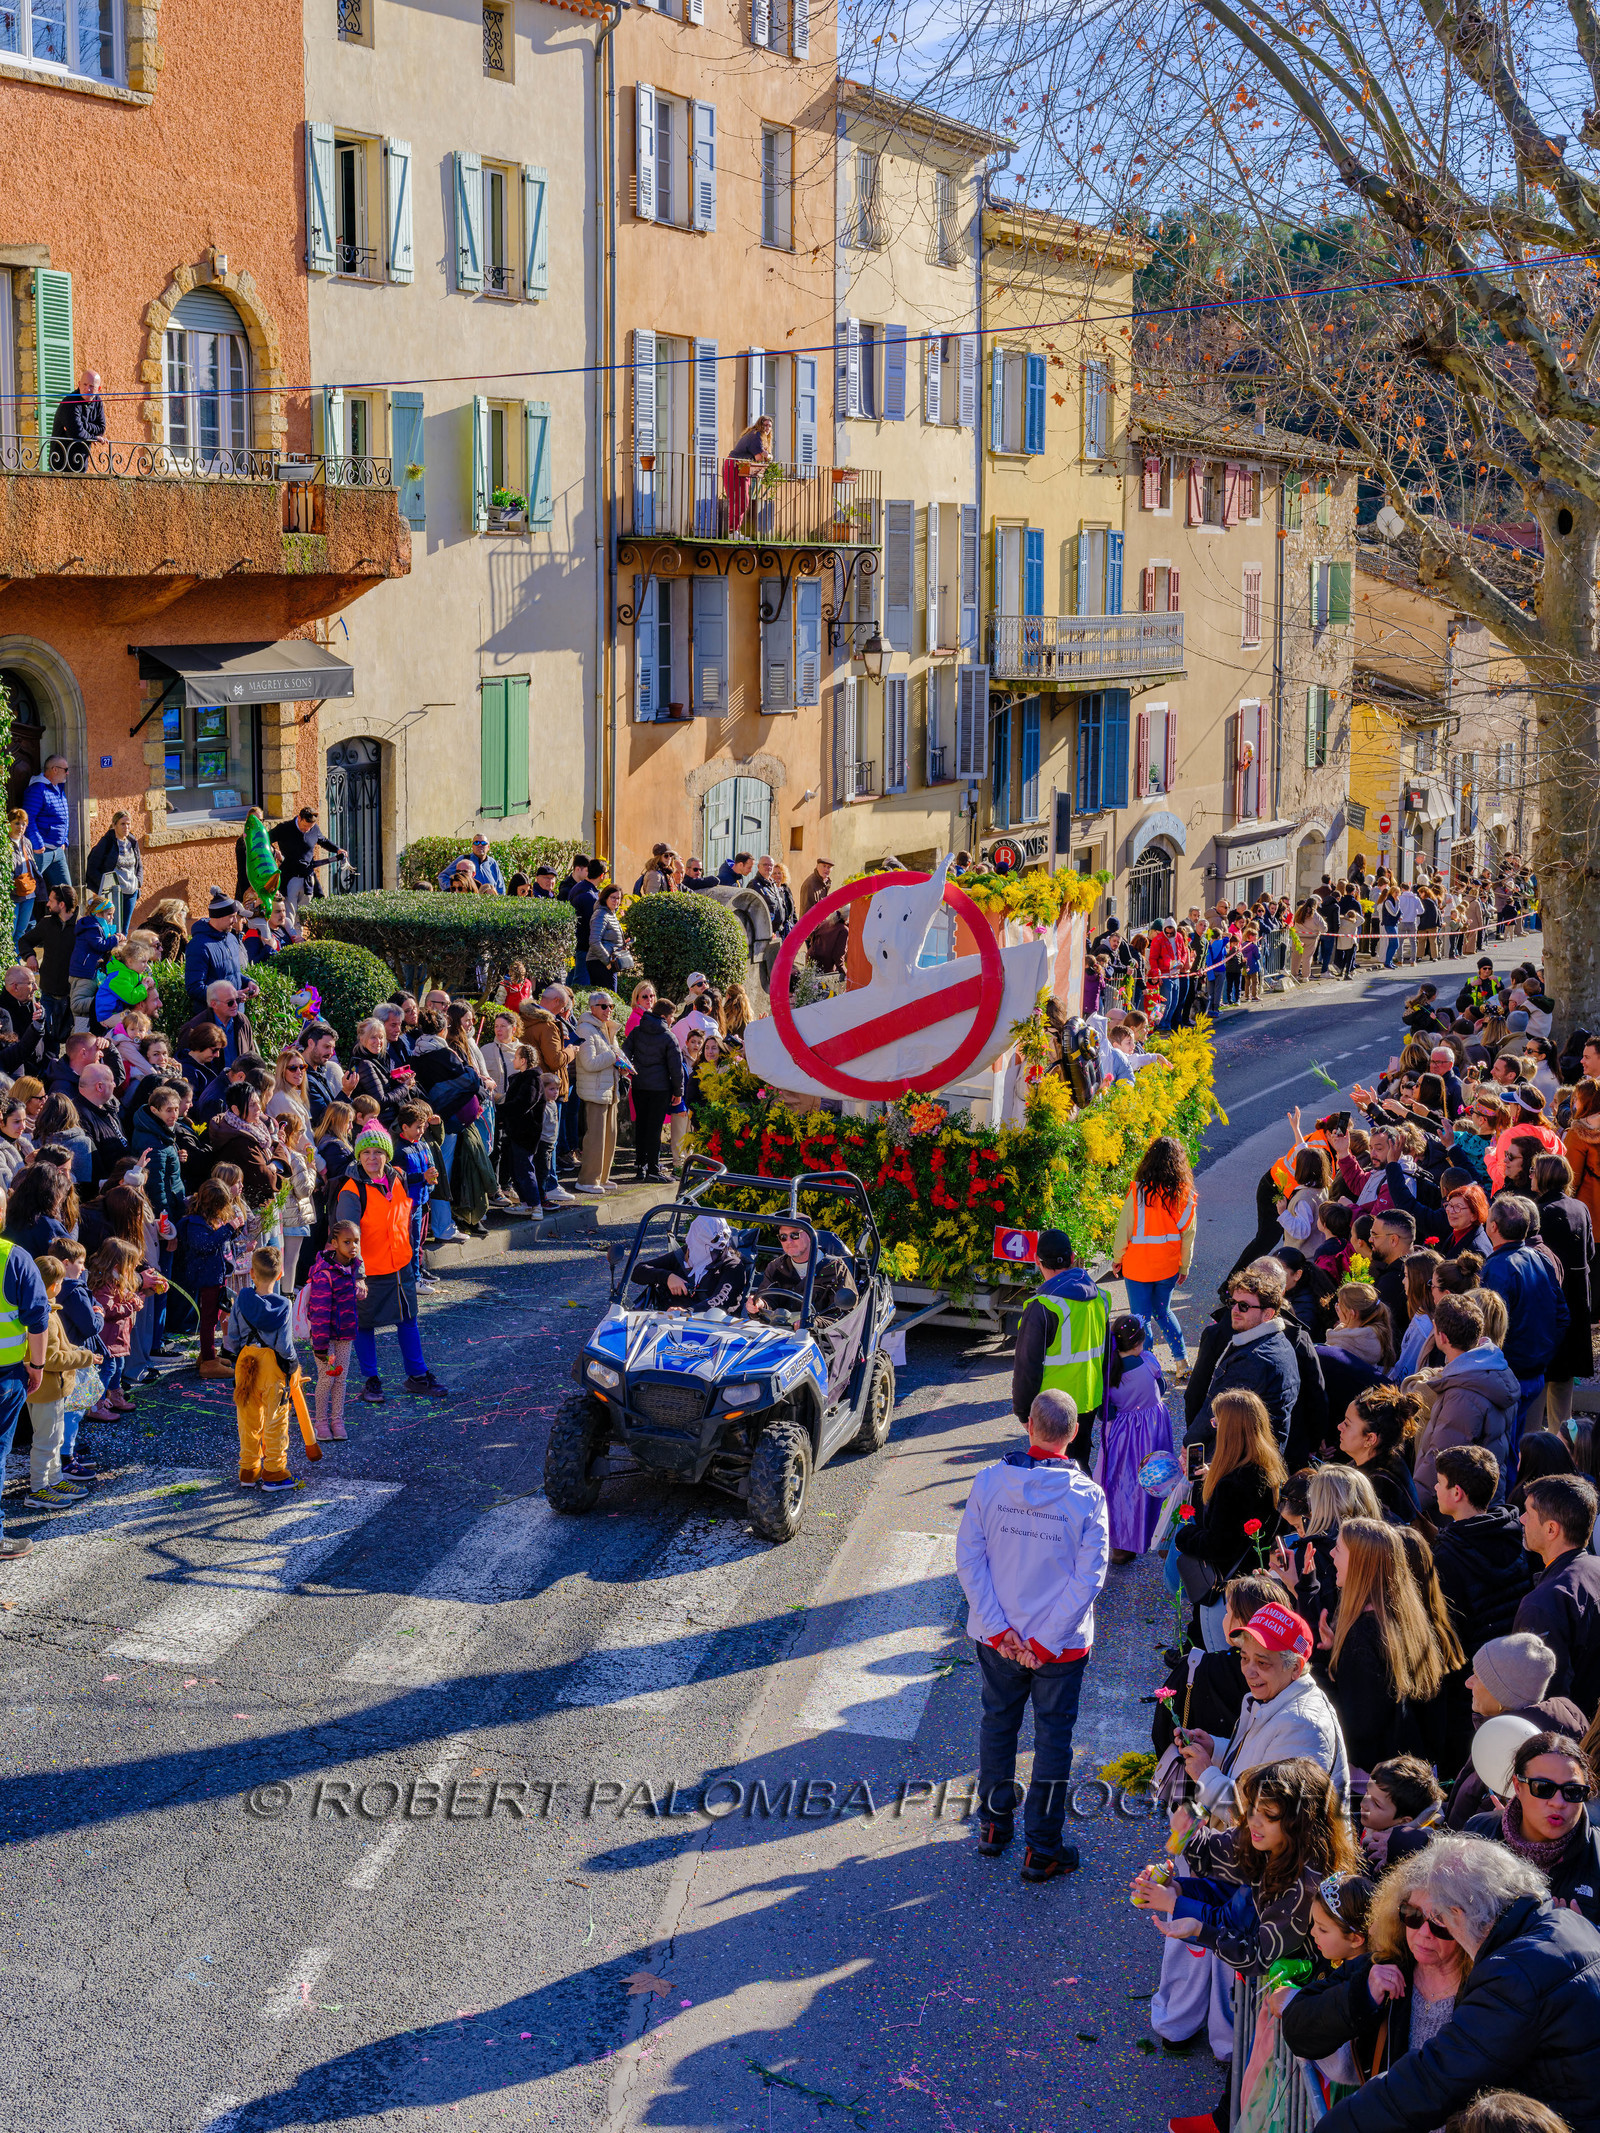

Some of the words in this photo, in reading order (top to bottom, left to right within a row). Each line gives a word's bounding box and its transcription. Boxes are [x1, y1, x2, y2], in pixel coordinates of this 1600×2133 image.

[248, 679, 281, 691] MAGREY
[284, 679, 290, 688] &
[291, 677, 312, 688] SONS
[103, 758, 110, 766] 27
[994, 840, 1018, 851] BARNES
[1006, 1234, 1024, 1257] 4
[707, 1282, 733, 1308] adidas
[665, 1345, 710, 1355] POLARIS
[785, 1350, 814, 1382] POLARIS
[997, 1504, 1025, 1515] Réserve
[1026, 1508, 1069, 1522] Communale
[1000, 1525, 1009, 1533] de
[1010, 1526, 1038, 1538] Sécurité
[1040, 1533, 1062, 1542] Civile
[1263, 1607, 1295, 1629] AMERICA
[1262, 1619, 1286, 1637] AGAIN
